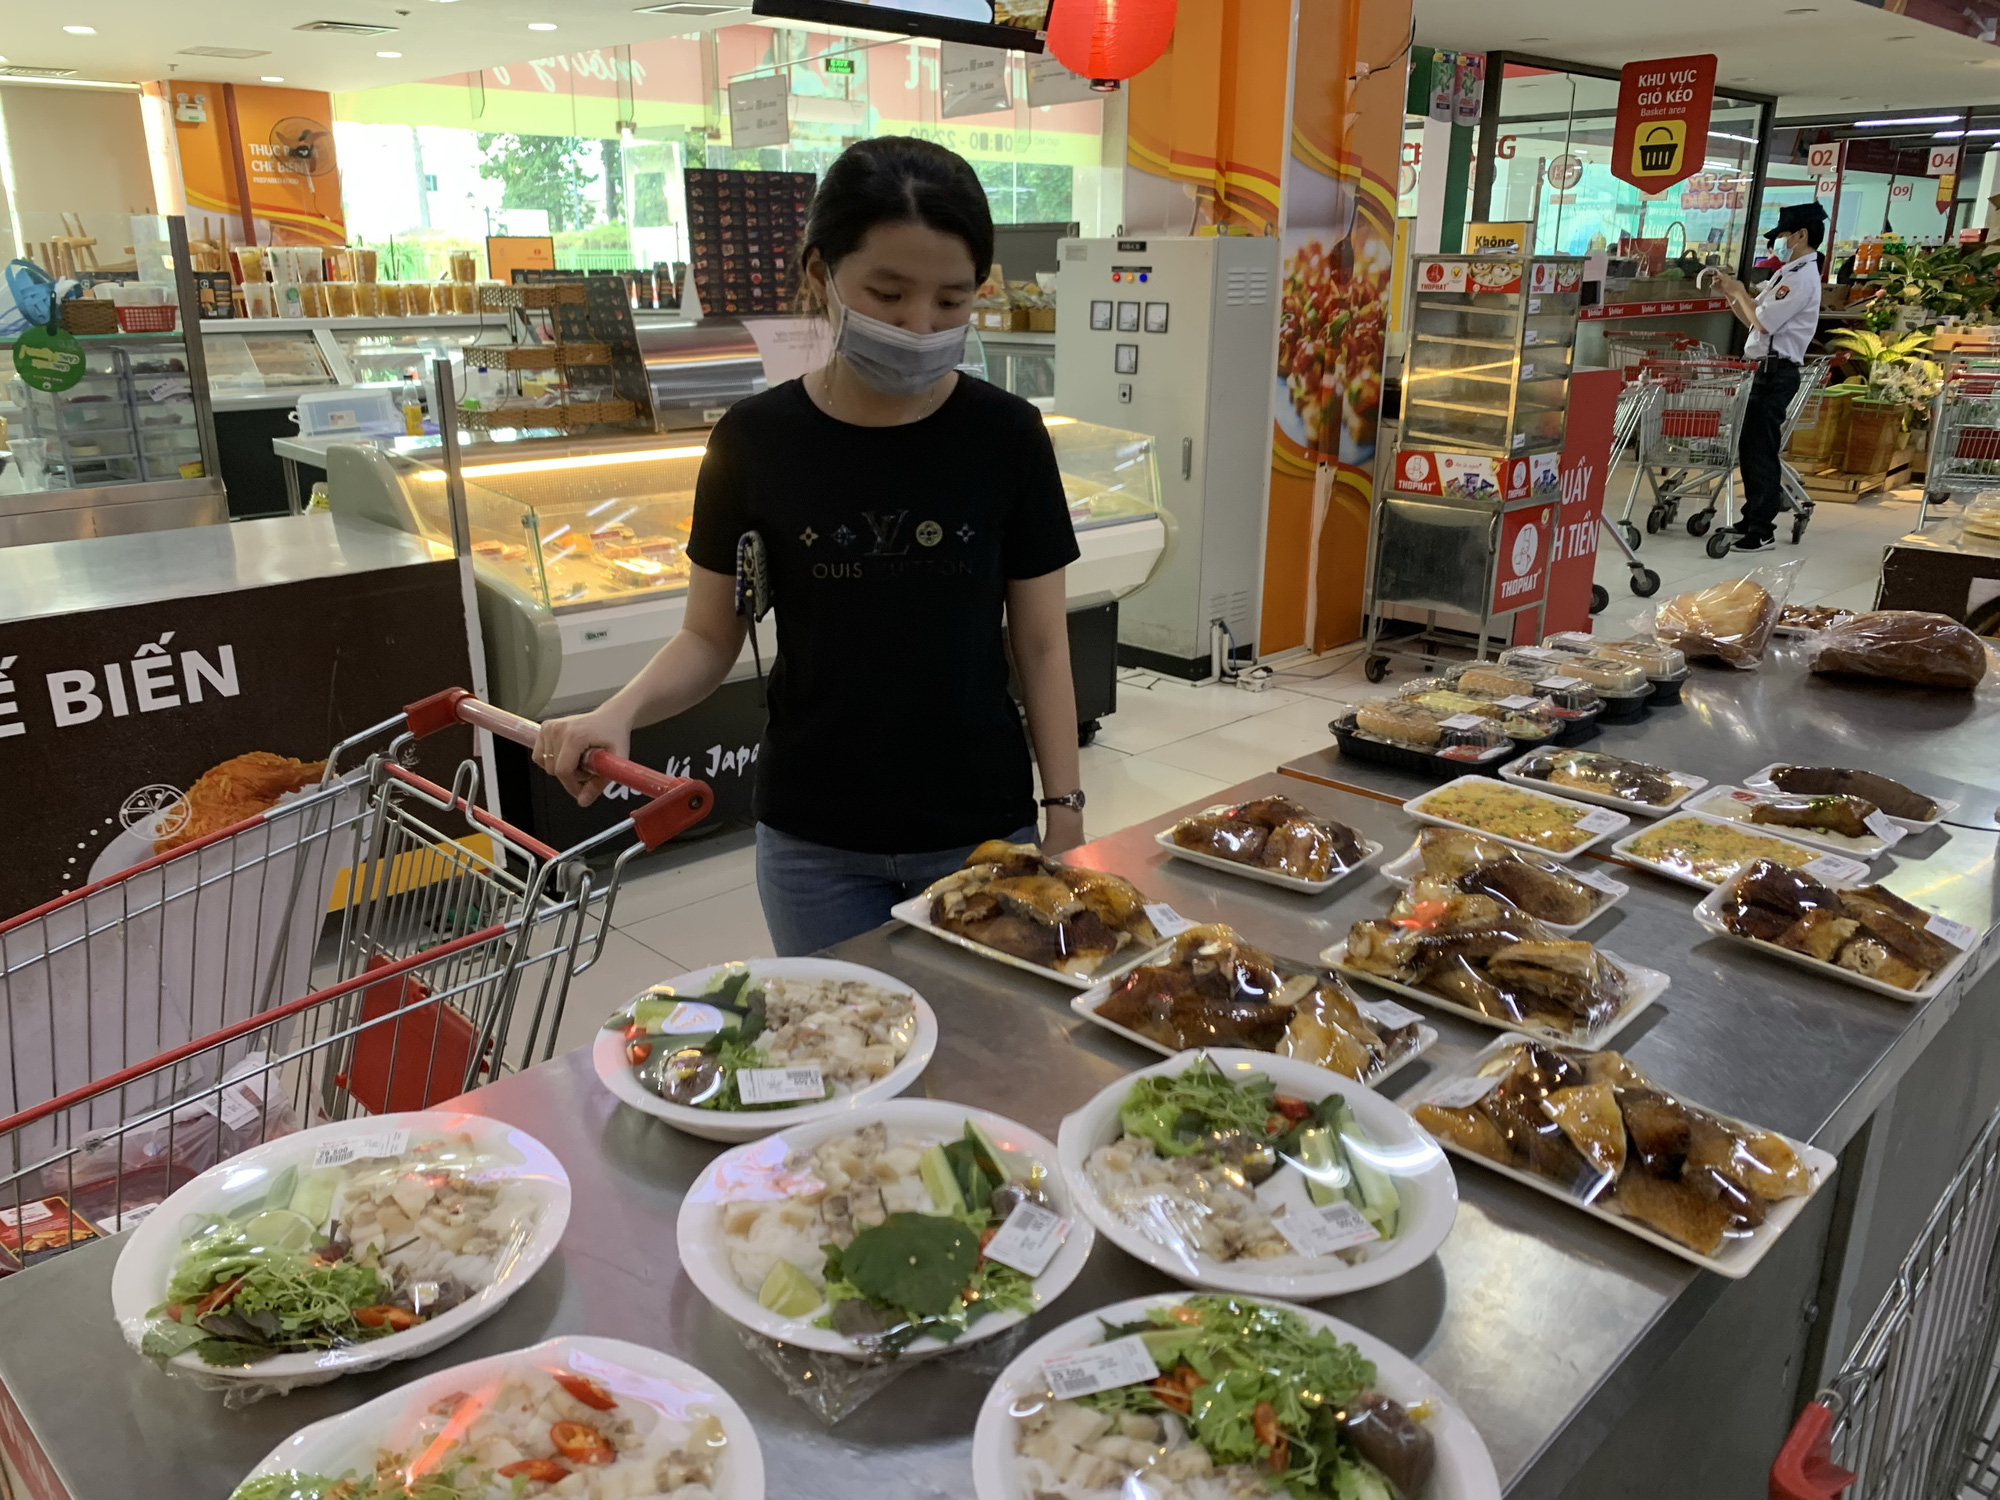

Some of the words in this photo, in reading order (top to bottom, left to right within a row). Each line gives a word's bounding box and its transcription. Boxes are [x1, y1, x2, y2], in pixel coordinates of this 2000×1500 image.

[1638, 72, 1666, 88] KHU
[1669, 69, 1697, 87] VỰC
[1637, 87, 1662, 106] GIỎ
[1666, 86, 1693, 104] KÉO
[1640, 107, 1666, 117] Basket
[1668, 106, 1686, 114] area
[1811, 150, 1833, 166] 02
[1932, 153, 1955, 167] 04
[1820, 181, 1836, 192] 07
[1893, 186, 1909, 196] 09
[1559, 455, 1592, 505] UẦY
[46, 631, 240, 727] BIẾN
